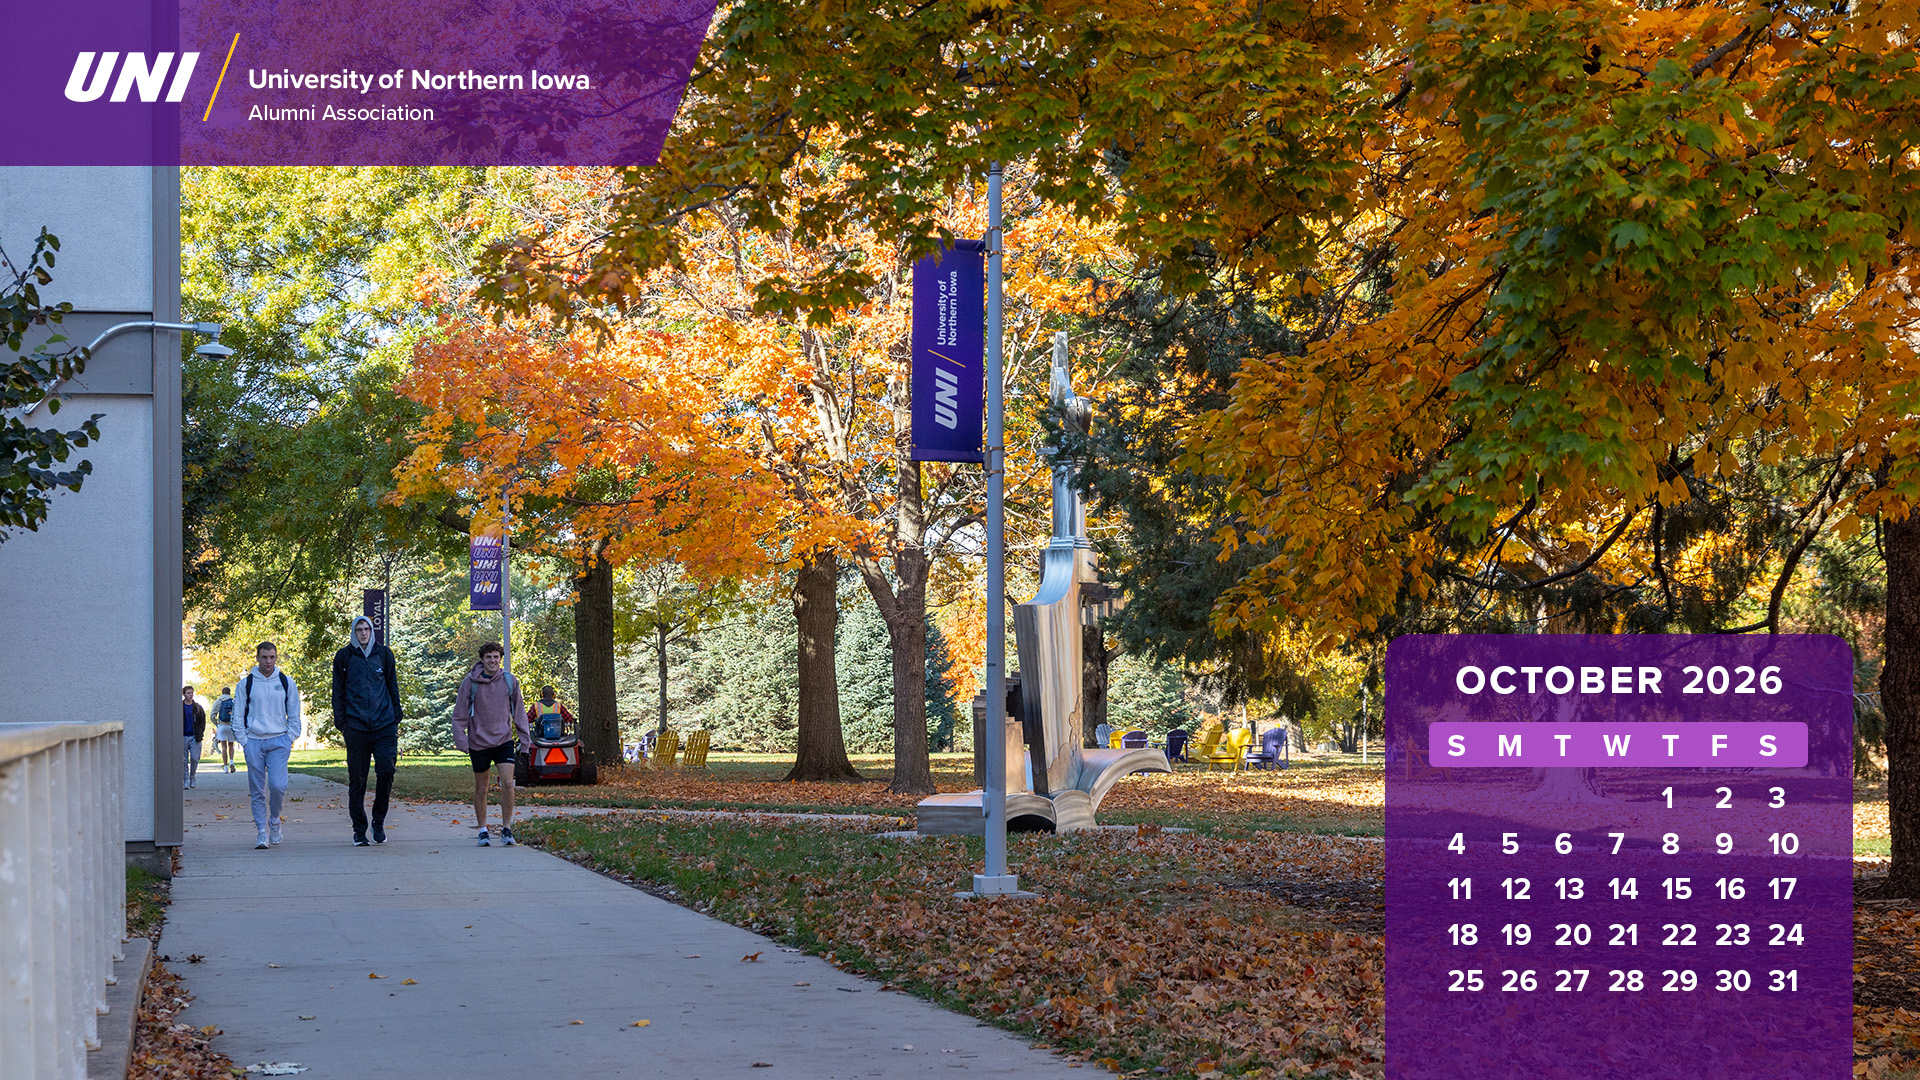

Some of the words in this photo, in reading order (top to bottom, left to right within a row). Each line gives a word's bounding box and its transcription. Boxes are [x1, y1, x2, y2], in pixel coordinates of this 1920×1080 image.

[937, 280, 947, 292] of
[948, 271, 957, 296] Iowa
[937, 292, 948, 346] University
[948, 298, 957, 346] Northern
[935, 366, 958, 430] UNI
[473, 536, 498, 546] UNI
[473, 547, 499, 559] UNI
[473, 570, 499, 582] UNI
[473, 583, 499, 593] UNI
